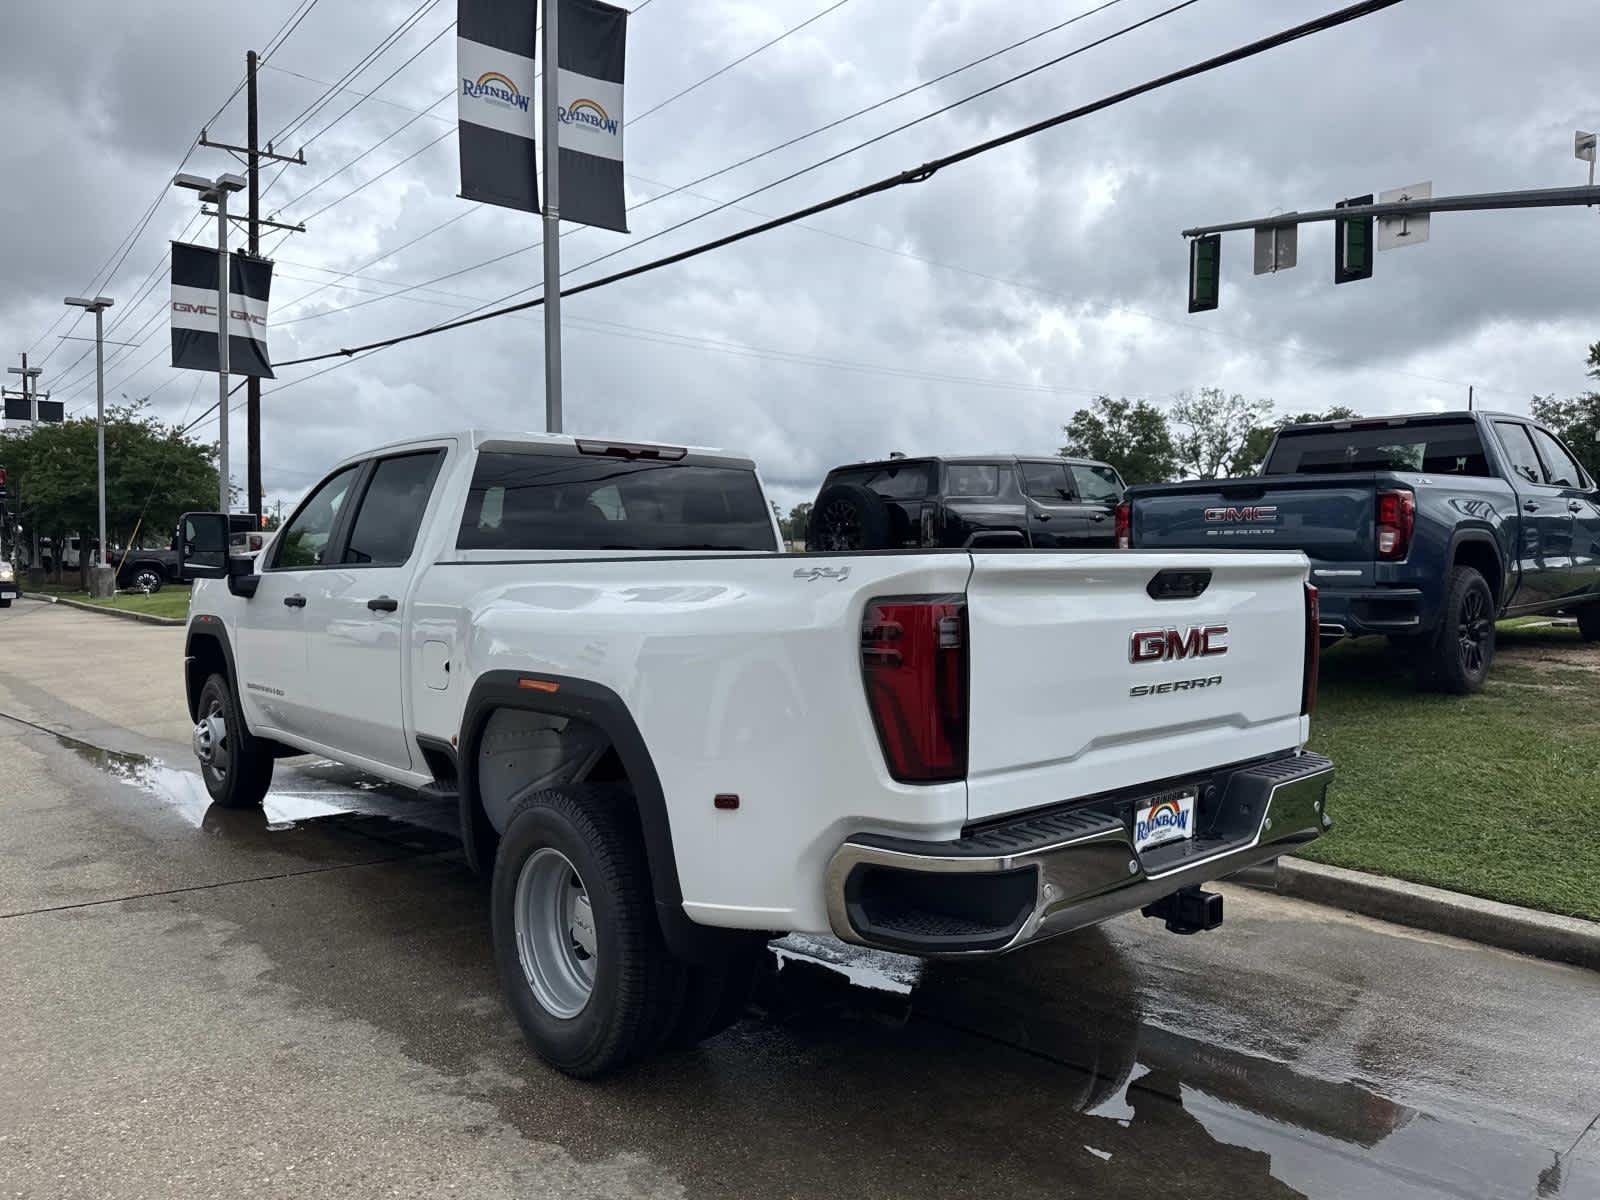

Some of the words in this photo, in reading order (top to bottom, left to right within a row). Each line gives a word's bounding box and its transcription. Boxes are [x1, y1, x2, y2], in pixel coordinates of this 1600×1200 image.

[462, 78, 530, 112] RAINBOW
[557, 106, 618, 136] RAINBOW
[173, 302, 217, 316] GMC
[230, 310, 266, 327] GMC
[1203, 506, 1278, 522] GMC
[1128, 624, 1229, 664] GMC
[1129, 675, 1223, 697] SIERRA
[1136, 809, 1190, 841] RAINBOW
